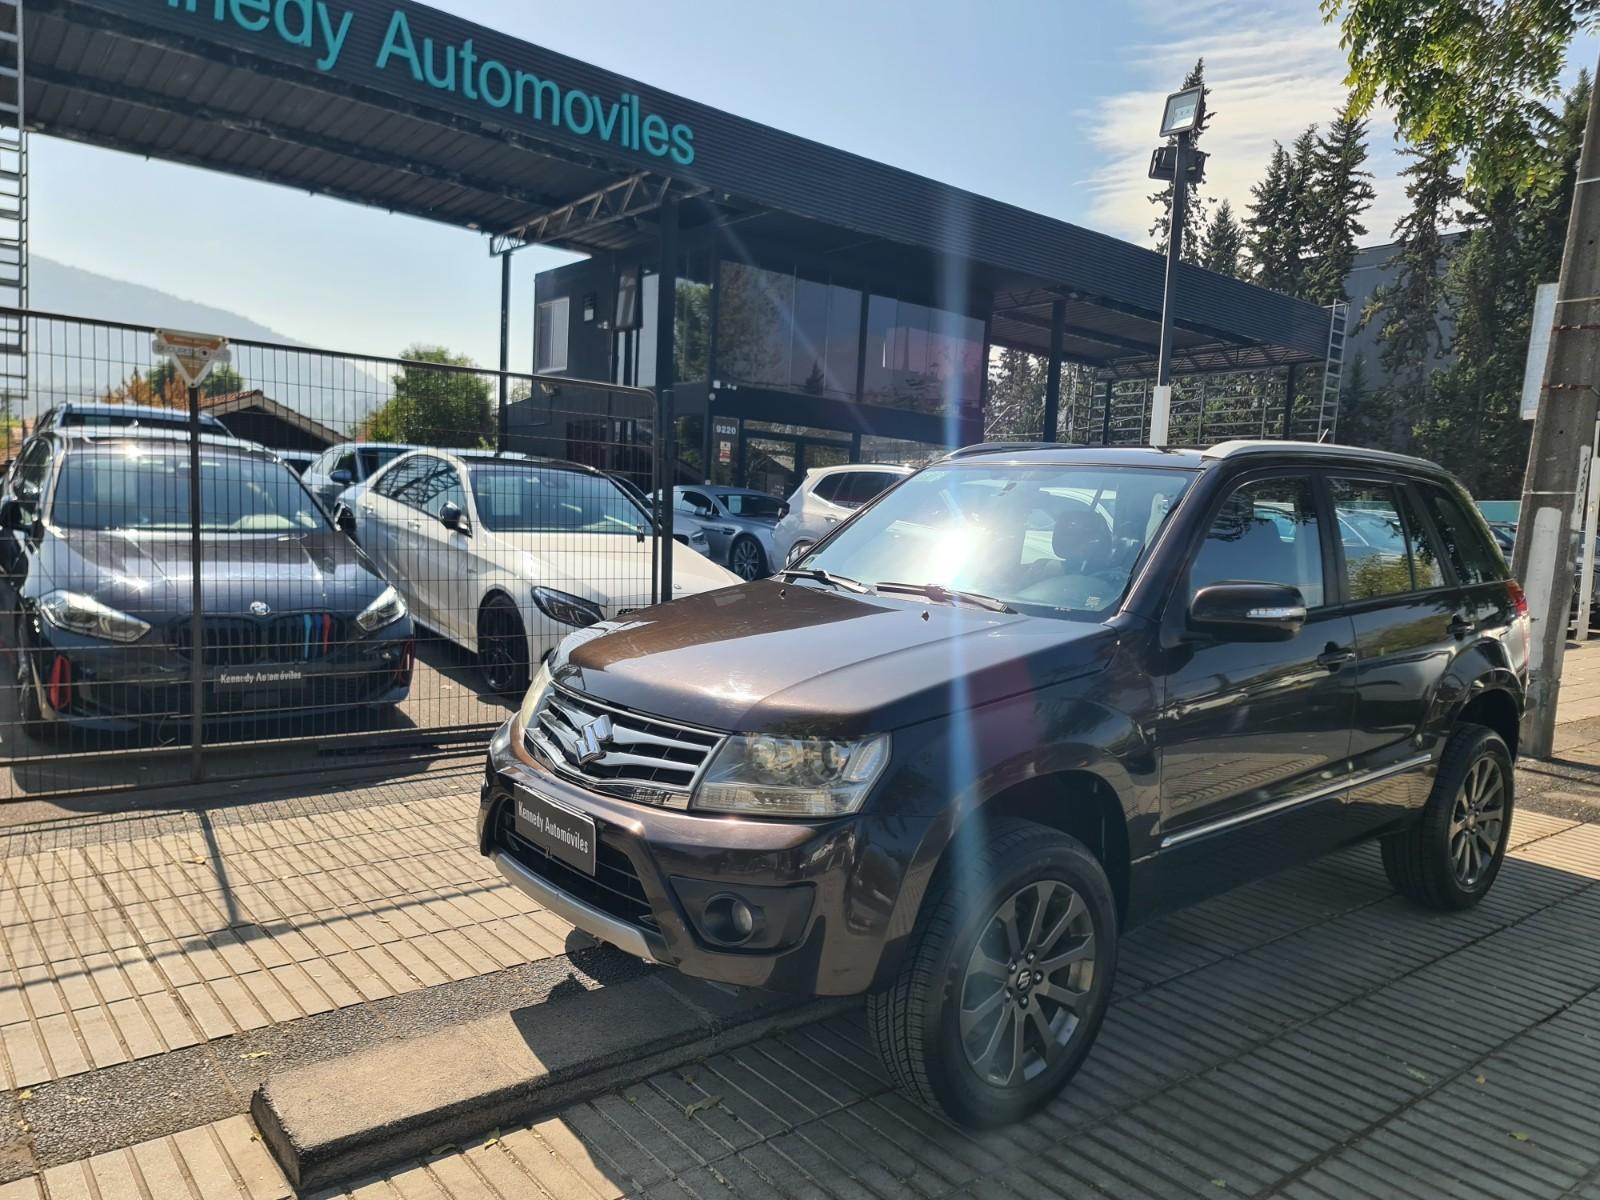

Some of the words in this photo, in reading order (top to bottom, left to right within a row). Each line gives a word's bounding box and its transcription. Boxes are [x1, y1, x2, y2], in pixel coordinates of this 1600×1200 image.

[376, 11, 694, 164] Automoviles
[518, 800, 543, 832] Kennedy
[545, 816, 588, 853] Automóviles
